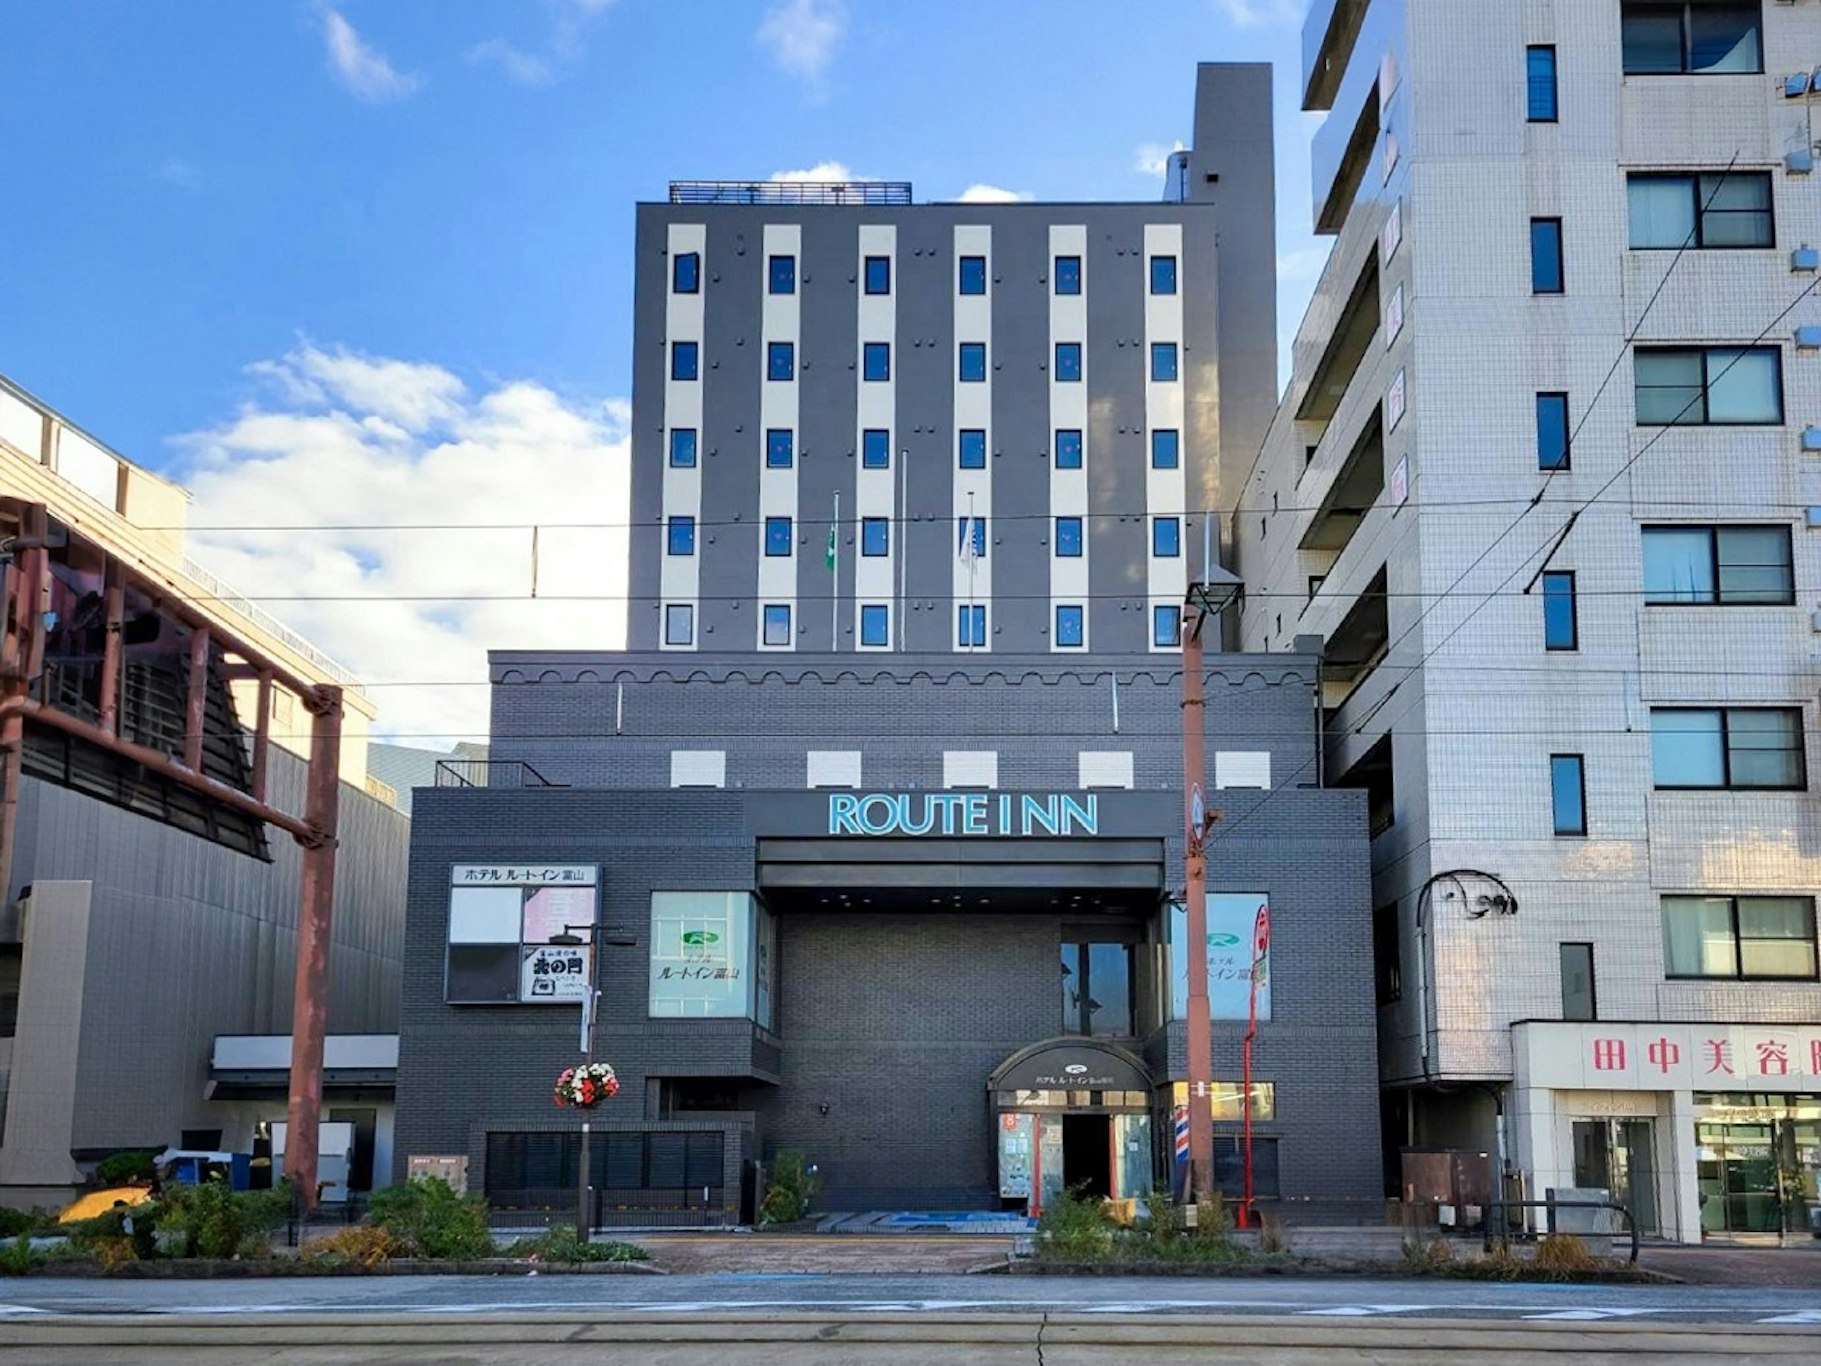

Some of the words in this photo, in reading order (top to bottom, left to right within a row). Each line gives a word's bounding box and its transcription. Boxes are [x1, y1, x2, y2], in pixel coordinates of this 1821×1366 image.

[828, 793, 989, 836] ROUTE
[999, 794, 1099, 836] INN
[465, 868, 502, 881] ホテル
